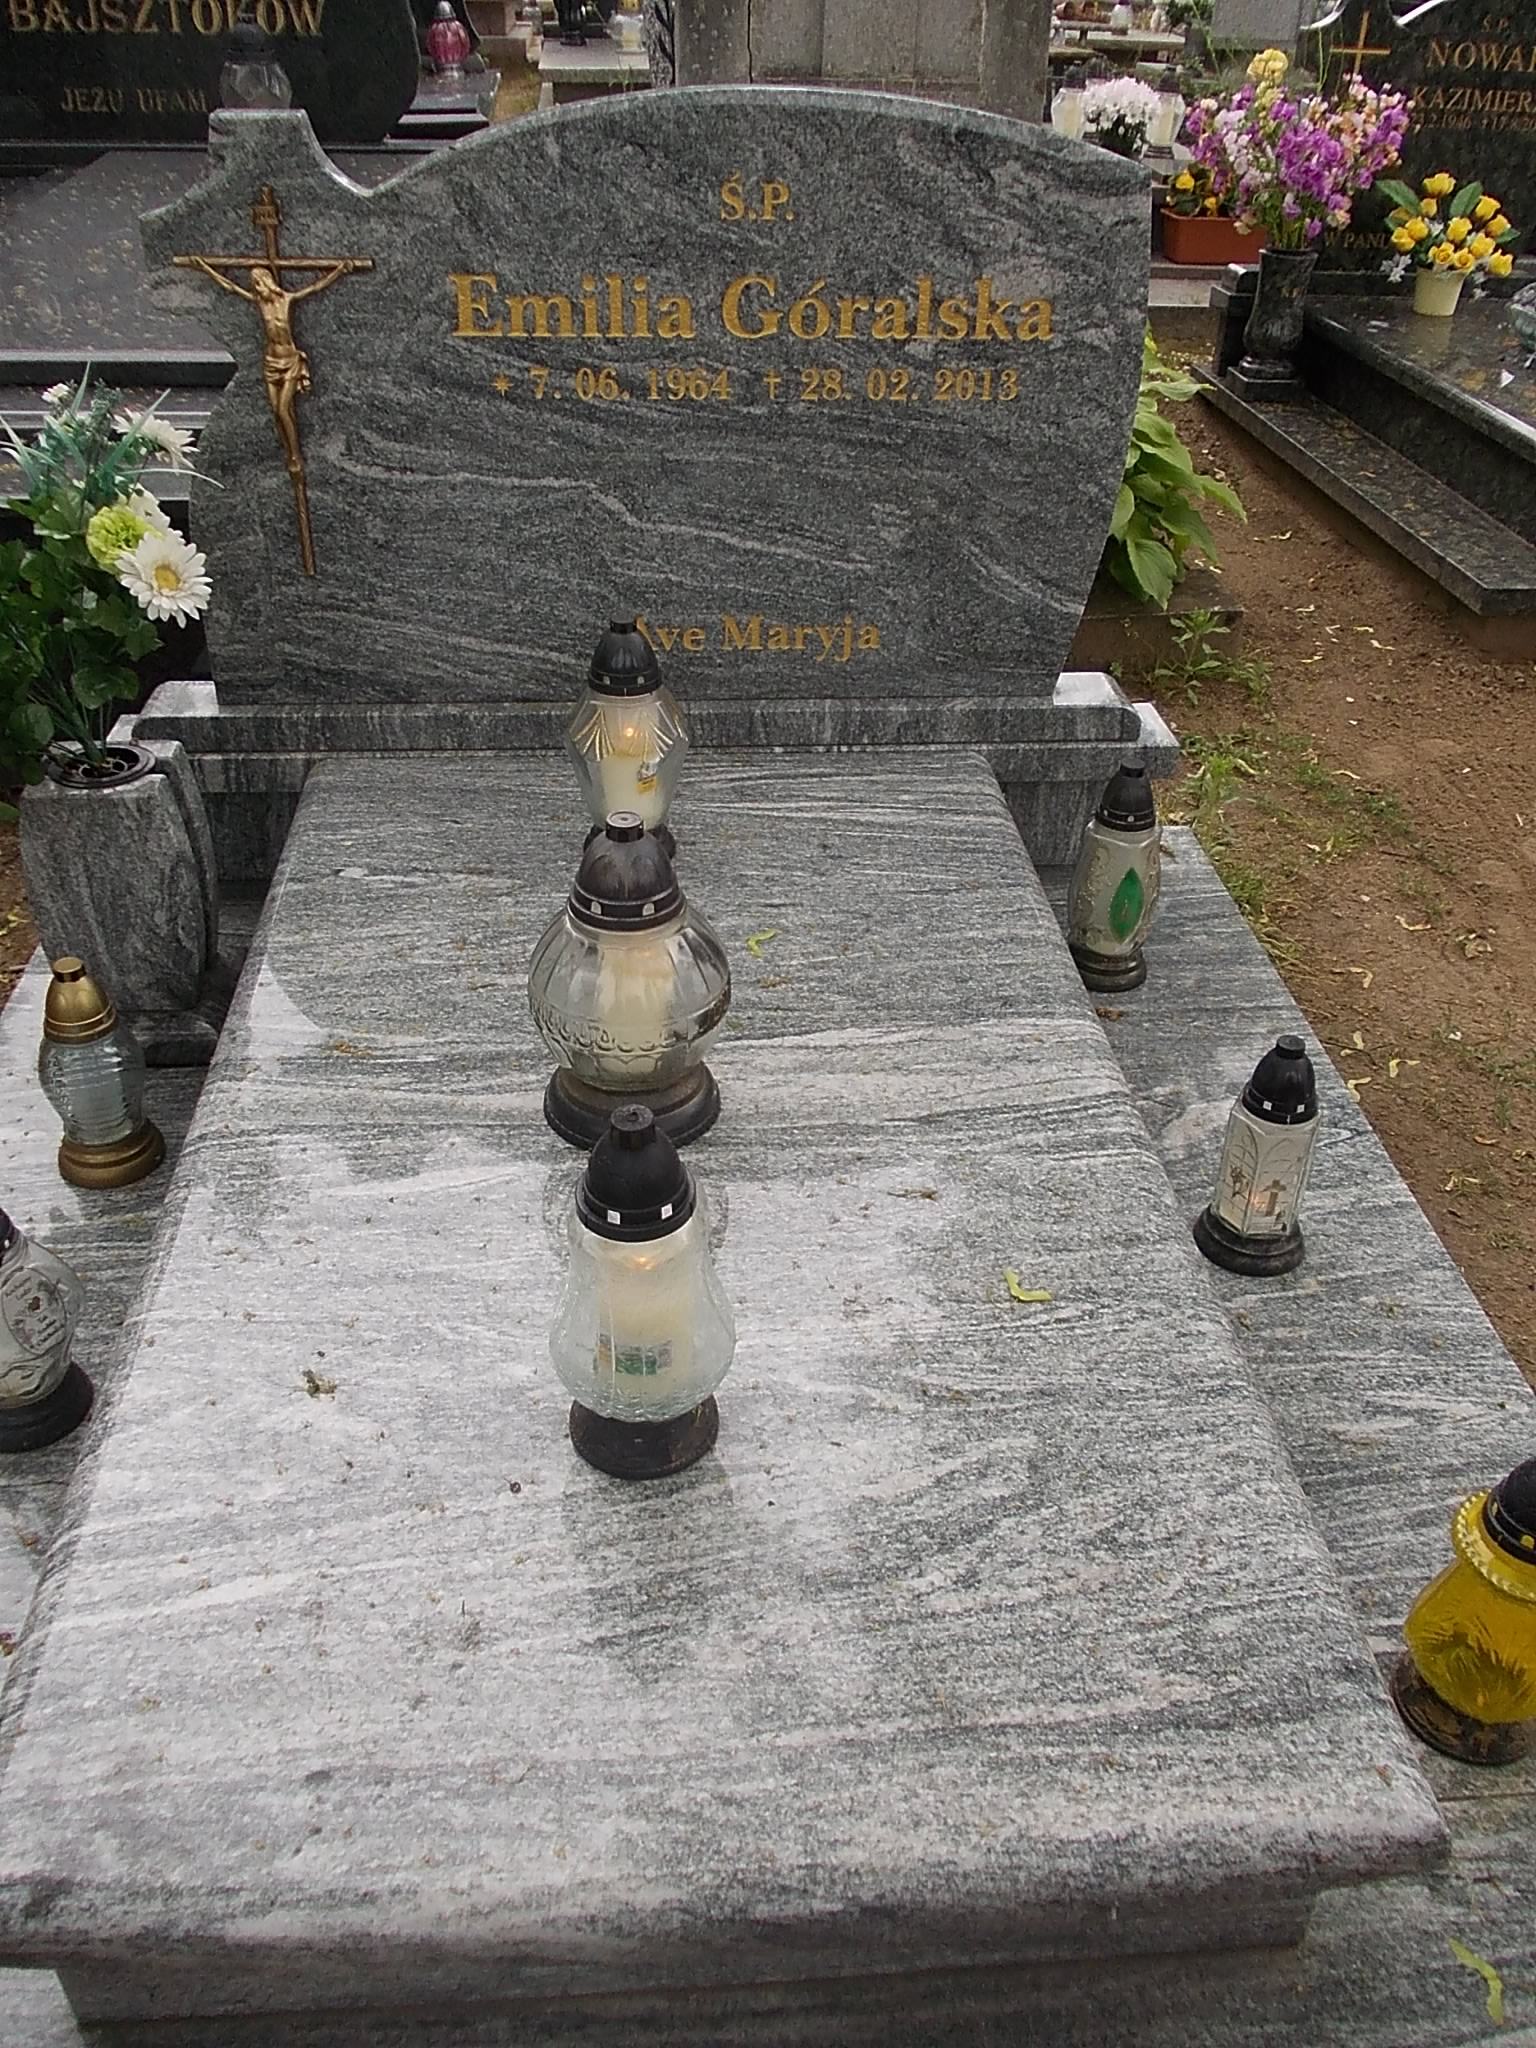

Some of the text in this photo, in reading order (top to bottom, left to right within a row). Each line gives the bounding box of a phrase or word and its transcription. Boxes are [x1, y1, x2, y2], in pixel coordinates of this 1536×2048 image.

[1426, 39, 1536, 72] NOWA
[1413, 86, 1536, 113] KAZIMIER
[720, 172, 794, 221] Ś.P.
[448, 272, 1054, 341] Emilia Góralska
[529, 367, 1019, 401] 7. 06. 1964 28. 02. 2013
[722, 613, 881, 662] Maryja
